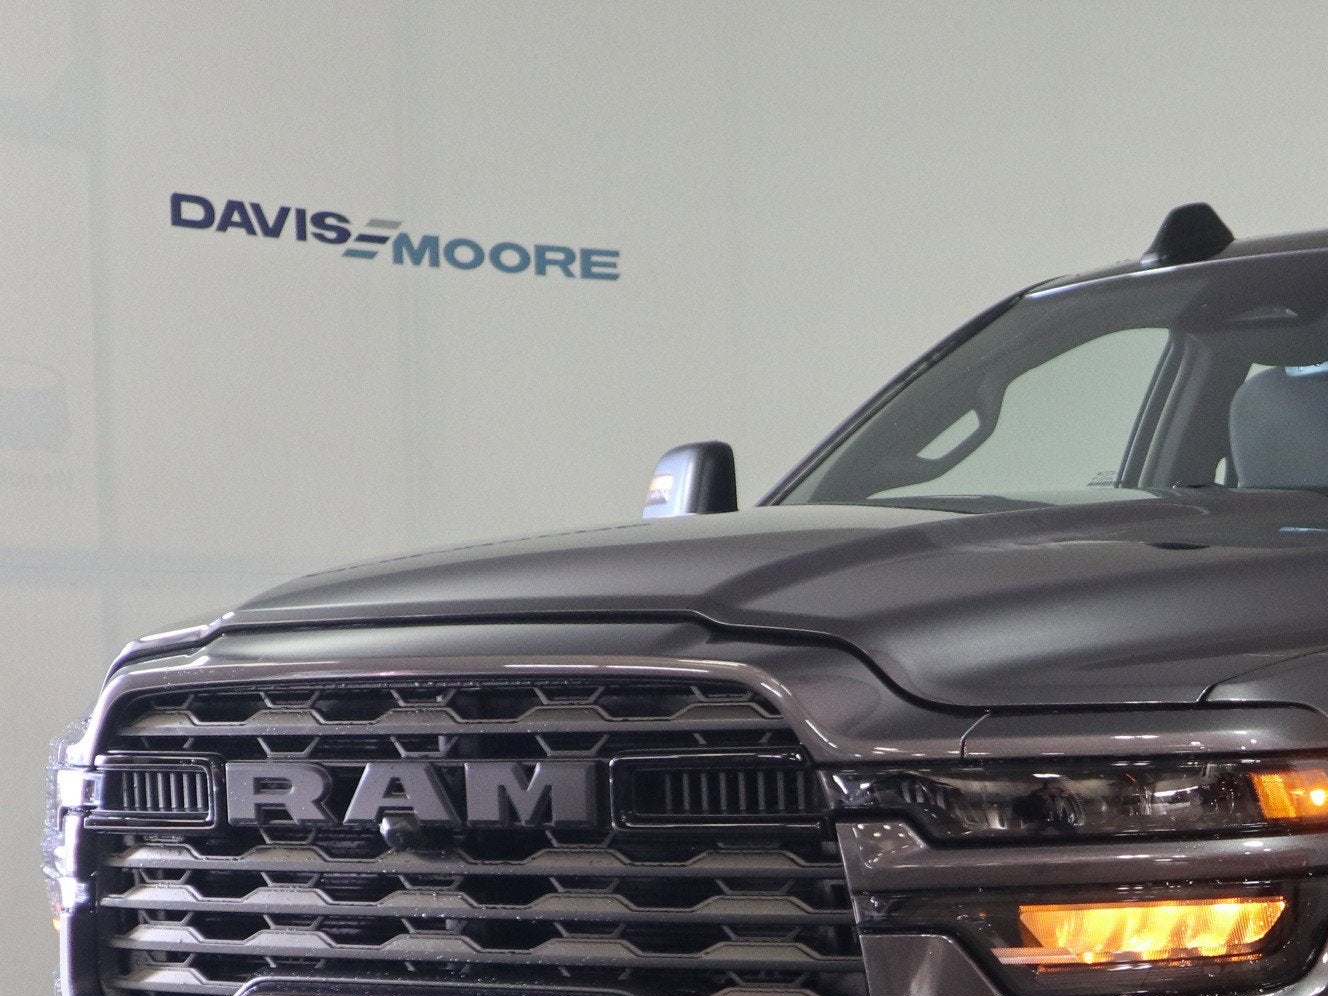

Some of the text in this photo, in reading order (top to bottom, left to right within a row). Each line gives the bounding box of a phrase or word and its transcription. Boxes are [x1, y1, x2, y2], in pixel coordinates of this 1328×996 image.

[170, 192, 620, 281] DAVIS MOORE
[225, 761, 604, 827] RAM
